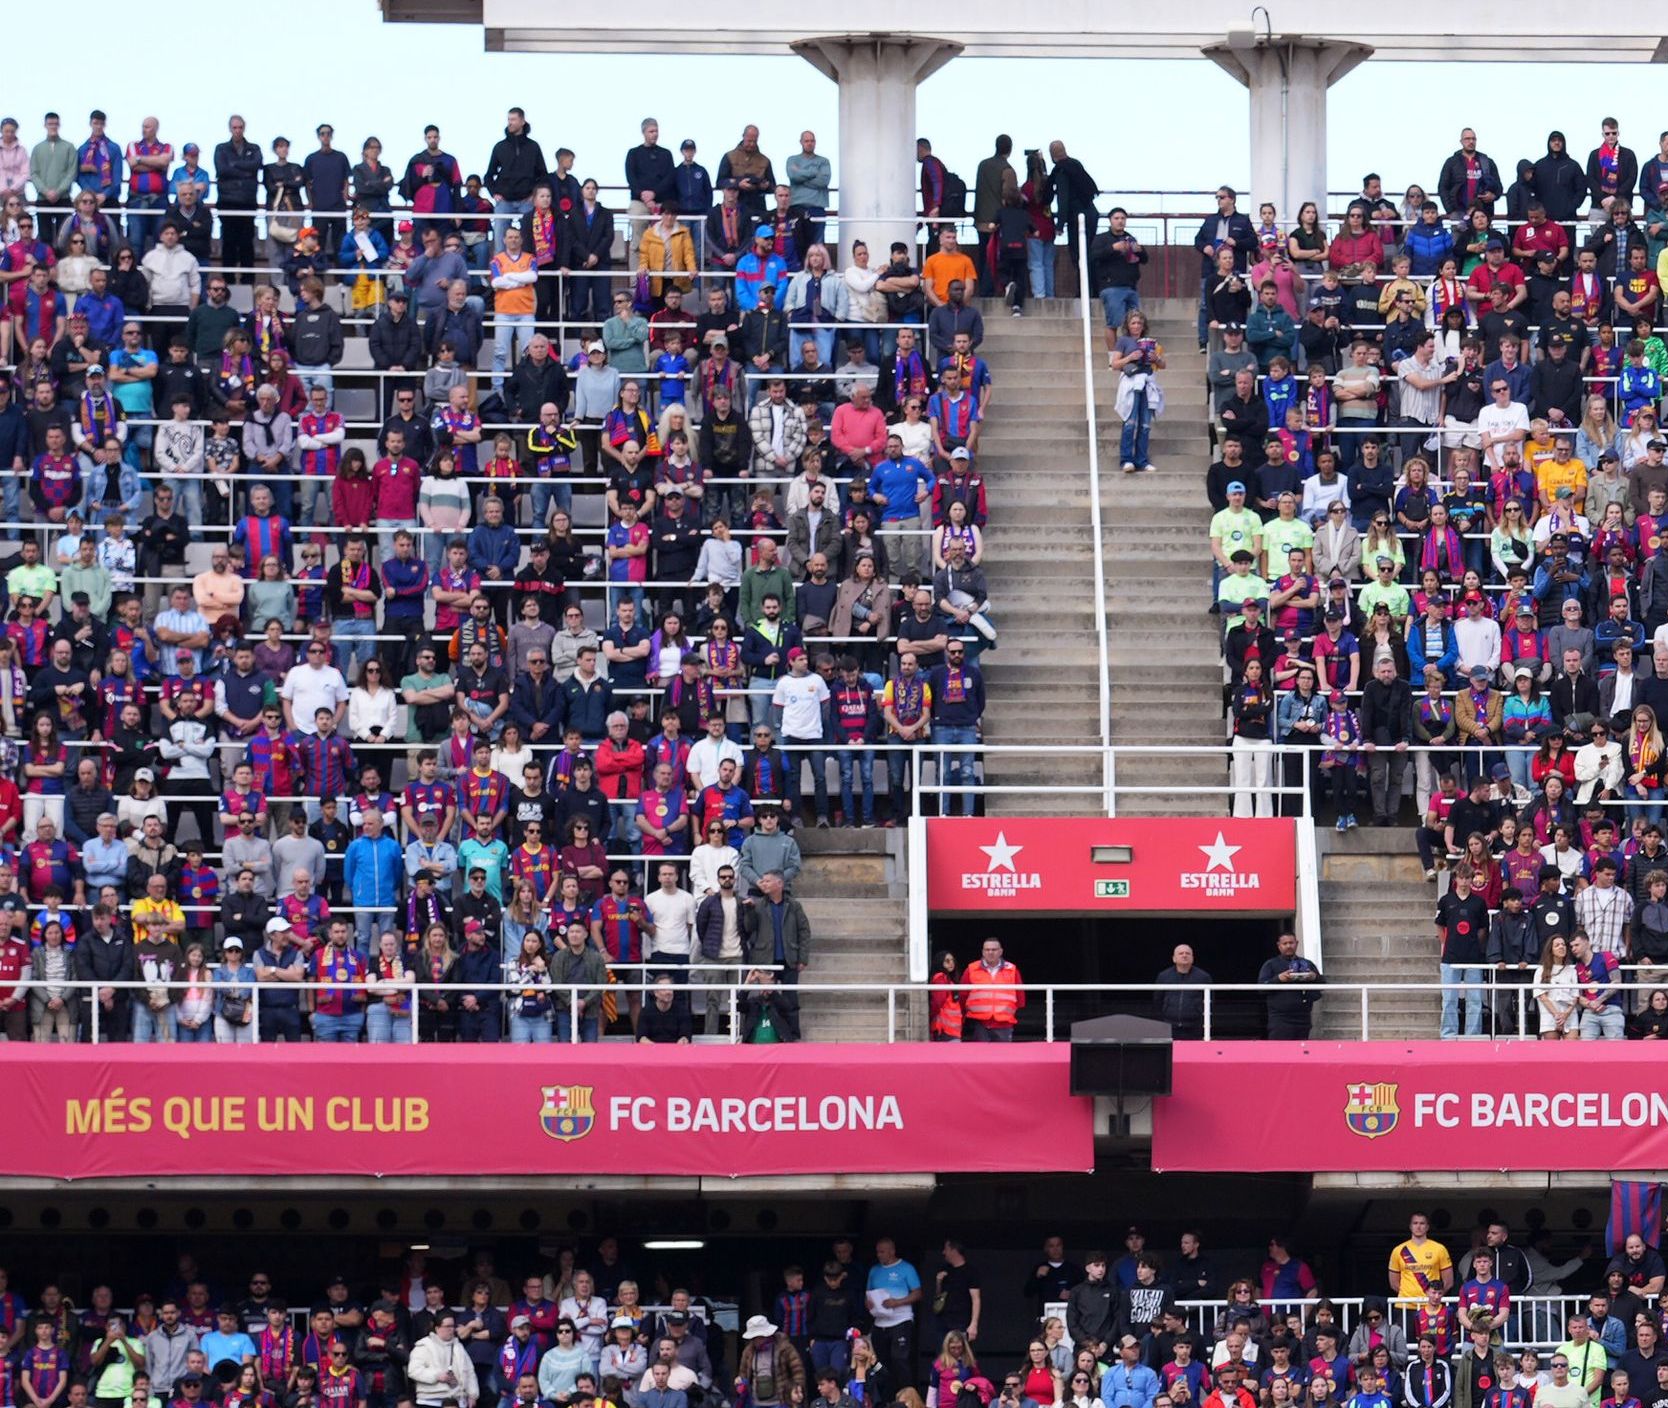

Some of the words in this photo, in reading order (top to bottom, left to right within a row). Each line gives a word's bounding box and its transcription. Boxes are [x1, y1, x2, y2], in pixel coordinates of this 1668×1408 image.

[841, 704, 865, 712] QATAR
[961, 872, 1041, 889] ESTRELLA
[1180, 872, 1260, 889] ESTRELLA
[987, 888, 1016, 896] DAMM
[1206, 888, 1235, 896] DAMM
[66, 1087, 151, 1133] MÉS
[163, 1096, 246, 1138] QUE
[257, 1096, 313, 1131] UN
[325, 1096, 430, 1132] CLUB
[610, 1096, 656, 1131] FC
[667, 1095, 903, 1133] BARCELONA
[1414, 1092, 1460, 1127] FC
